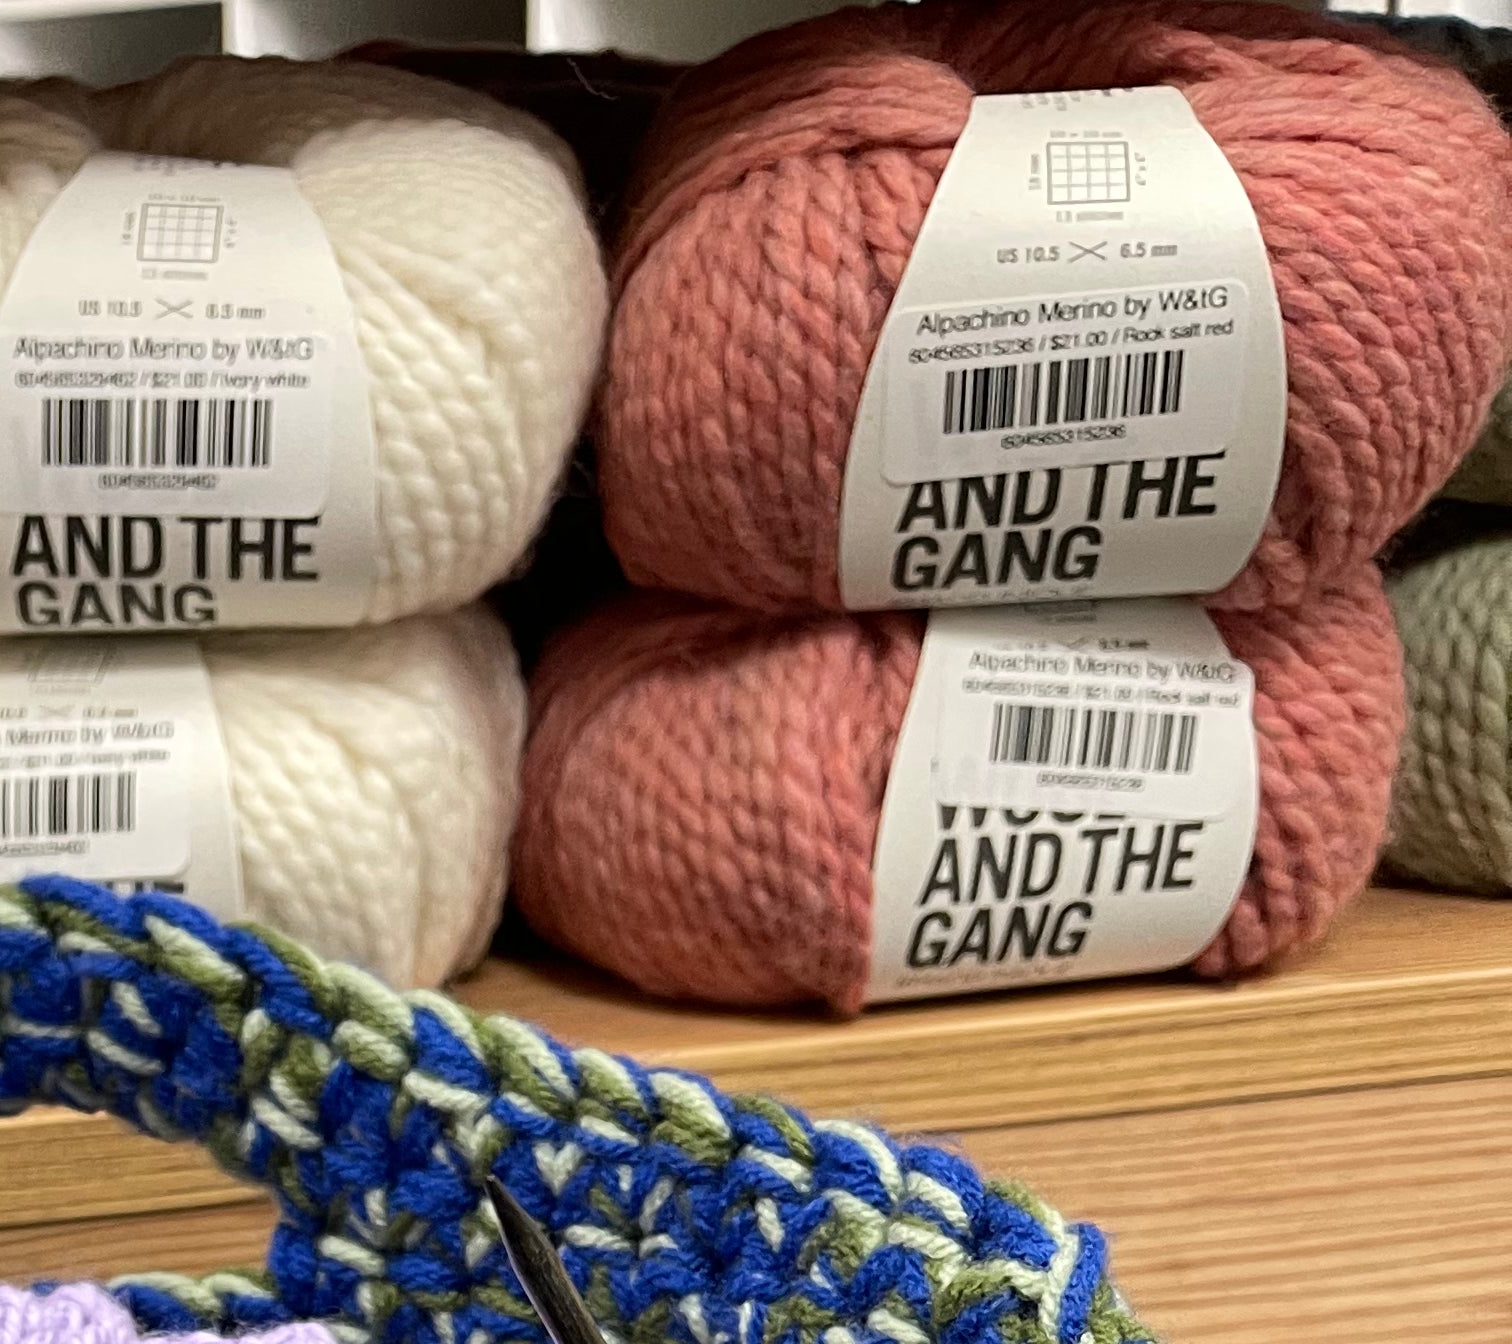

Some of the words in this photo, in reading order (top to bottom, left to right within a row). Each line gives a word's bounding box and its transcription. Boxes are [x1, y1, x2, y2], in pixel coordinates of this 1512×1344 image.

[996, 248, 1019, 263] US
[1026, 246, 1060, 262] 10.5
[1120, 242, 1146, 258] 6.5
[916, 306, 1030, 338] Alpachino
[1038, 299, 1118, 324] Merino
[1124, 295, 1152, 320] by
[1158, 286, 1229, 312] W&tG
[1051, 329, 1108, 350] $21.00
[1123, 325, 1165, 343] Rock
[1170, 322, 1201, 340] salt
[1205, 318, 1234, 336] red
[13, 337, 125, 365] Alpachino
[129, 337, 207, 360] Merino
[212, 337, 240, 366] by
[897, 465, 1061, 533] AND
[1087, 448, 1226, 521] THE
[11, 514, 163, 579] AND
[179, 516, 320, 581] THE
[892, 524, 1103, 593] GANG
[16, 581, 216, 626] GANG
[918, 831, 1062, 908] AND
[1079, 821, 1205, 896] THE
[905, 899, 1094, 969] GANG
